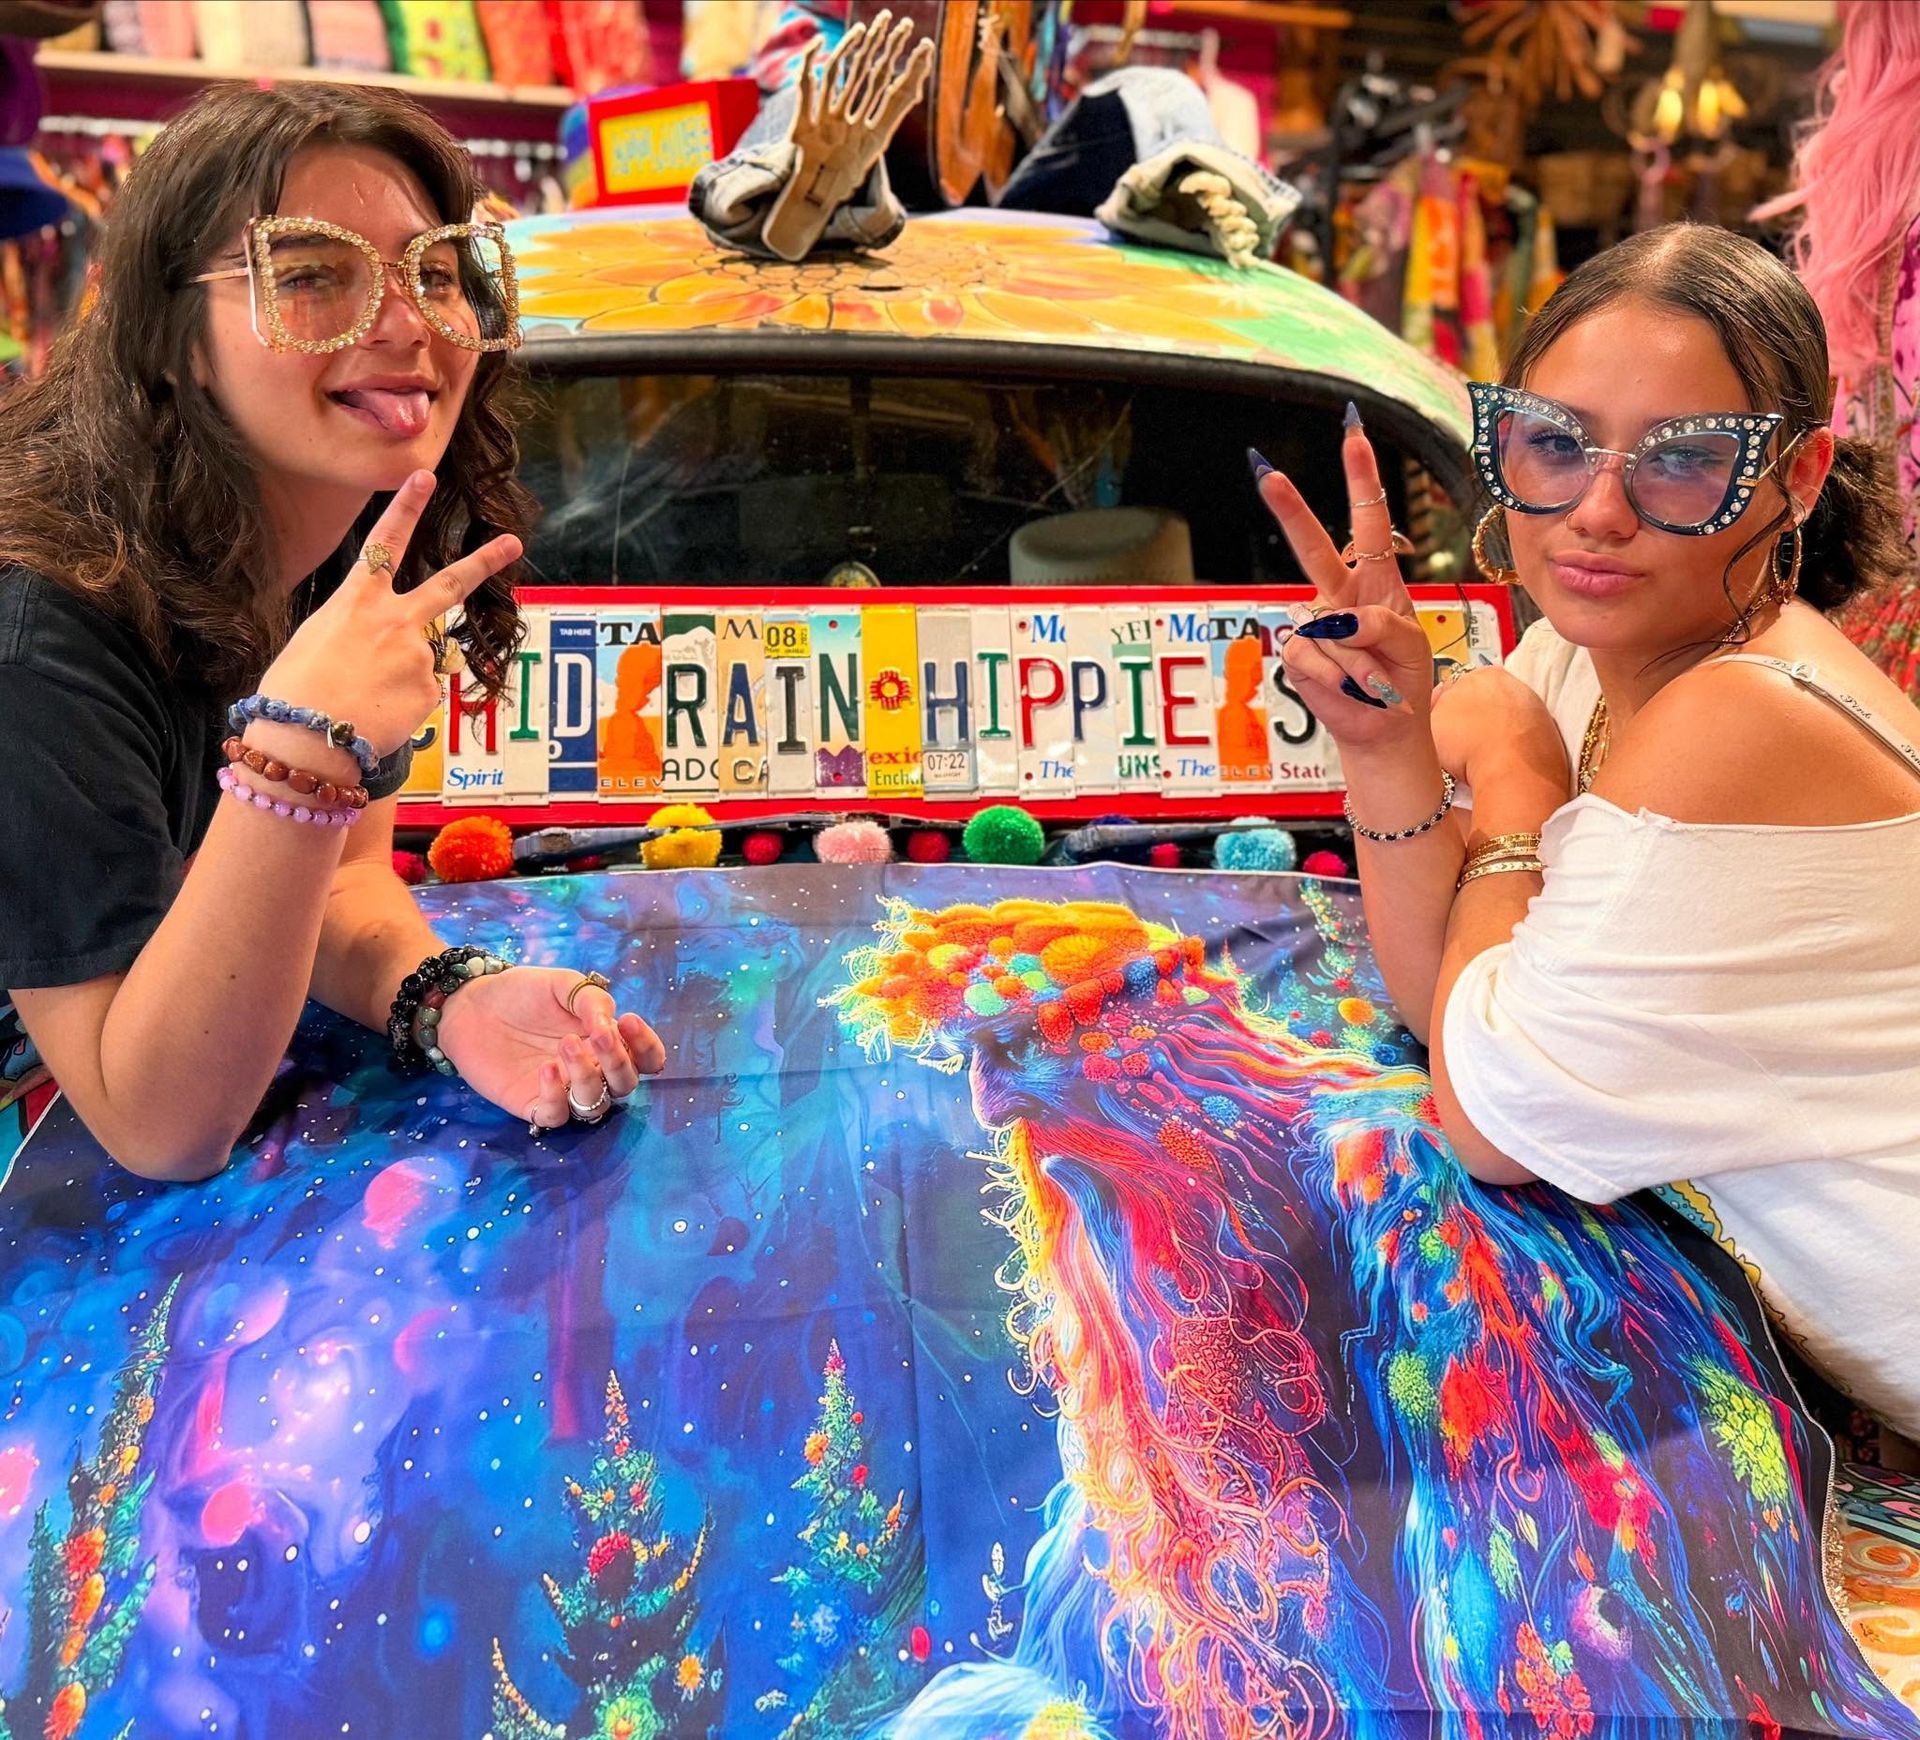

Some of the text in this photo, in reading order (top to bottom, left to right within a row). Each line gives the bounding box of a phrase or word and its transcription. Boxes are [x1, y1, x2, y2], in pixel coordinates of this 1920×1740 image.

[573, 628, 592, 636] HERE
[597, 622, 661, 646] TA
[766, 626, 797, 648] 08
[1470, 615, 1480, 647] SEP
[666, 652, 860, 755] RAIN
[447, 767, 504, 790] Spirit
[1177, 759, 1216, 777] The
